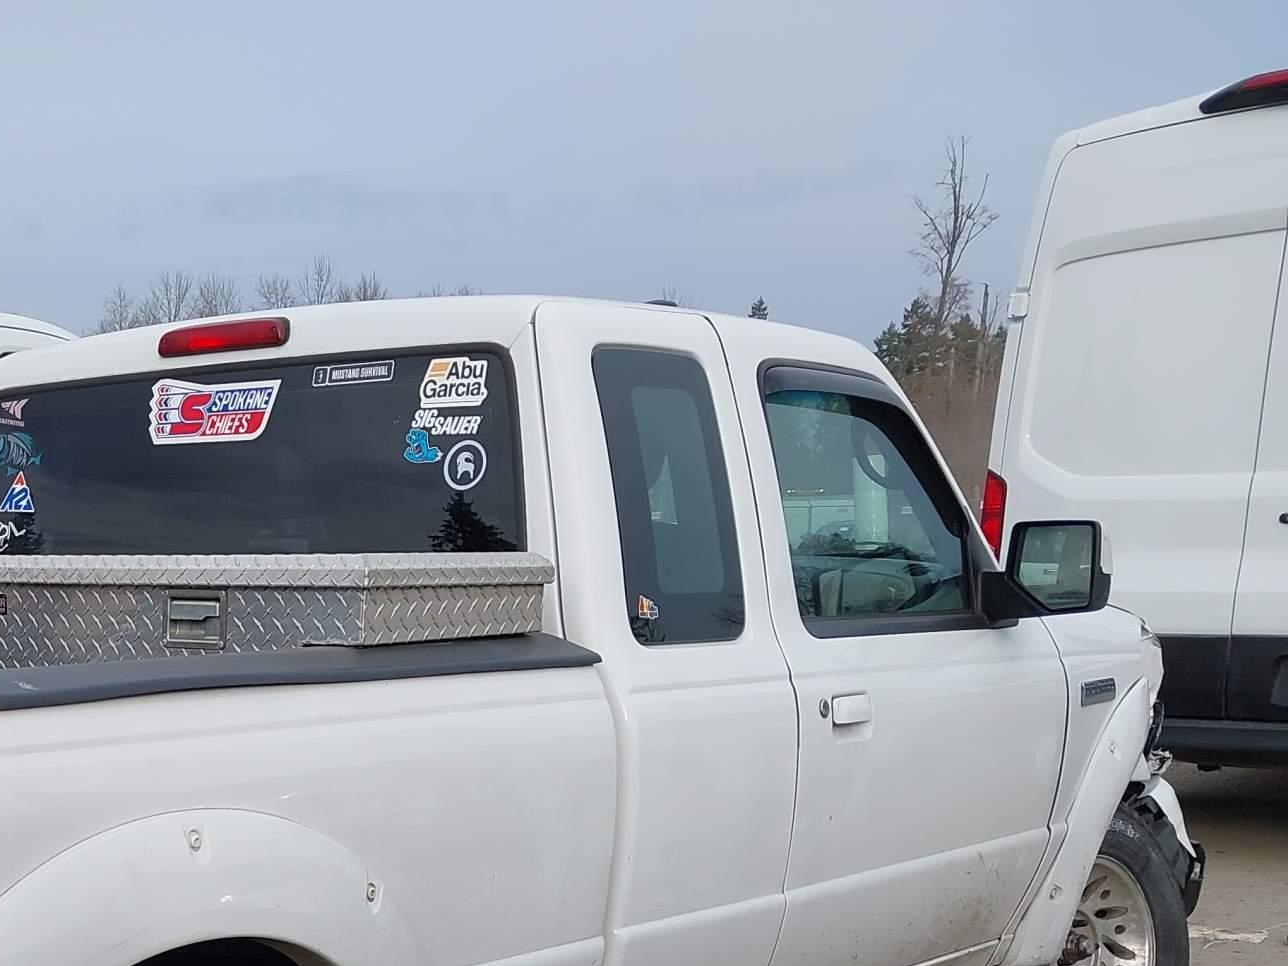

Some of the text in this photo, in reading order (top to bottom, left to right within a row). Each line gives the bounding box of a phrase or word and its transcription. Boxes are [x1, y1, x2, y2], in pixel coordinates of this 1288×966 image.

[331, 365, 389, 380] MUSTANG SURVIVAL
[446, 360, 485, 380] Abu
[422, 379, 484, 399] Garcia
[211, 388, 273, 412] SPOKANE
[204, 413, 251, 436] CHIEFS
[412, 408, 482, 435] SIG SAUER
